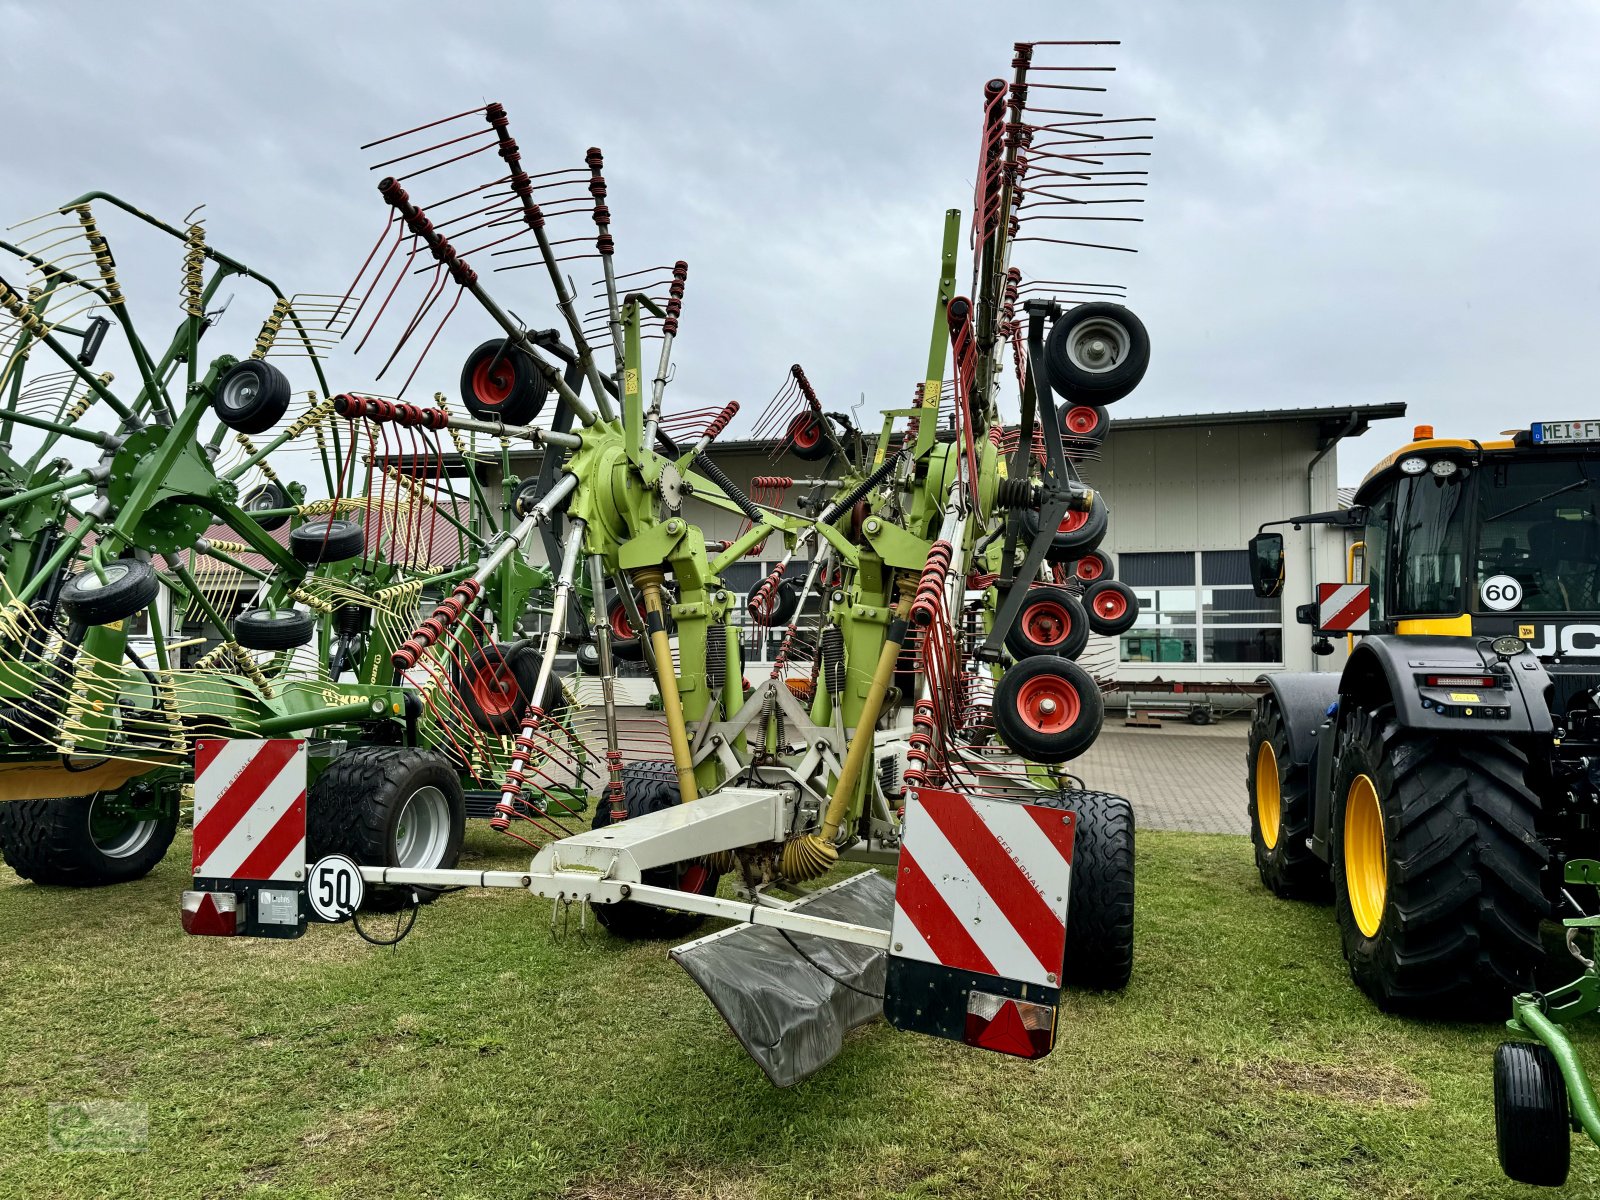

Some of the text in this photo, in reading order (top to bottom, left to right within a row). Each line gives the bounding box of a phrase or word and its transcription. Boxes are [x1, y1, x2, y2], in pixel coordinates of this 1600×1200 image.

[1543, 424, 1573, 439] MEI
[1486, 584, 1518, 602] 60
[996, 835, 1046, 898] CFG SGNALE
[319, 867, 352, 909] 50
